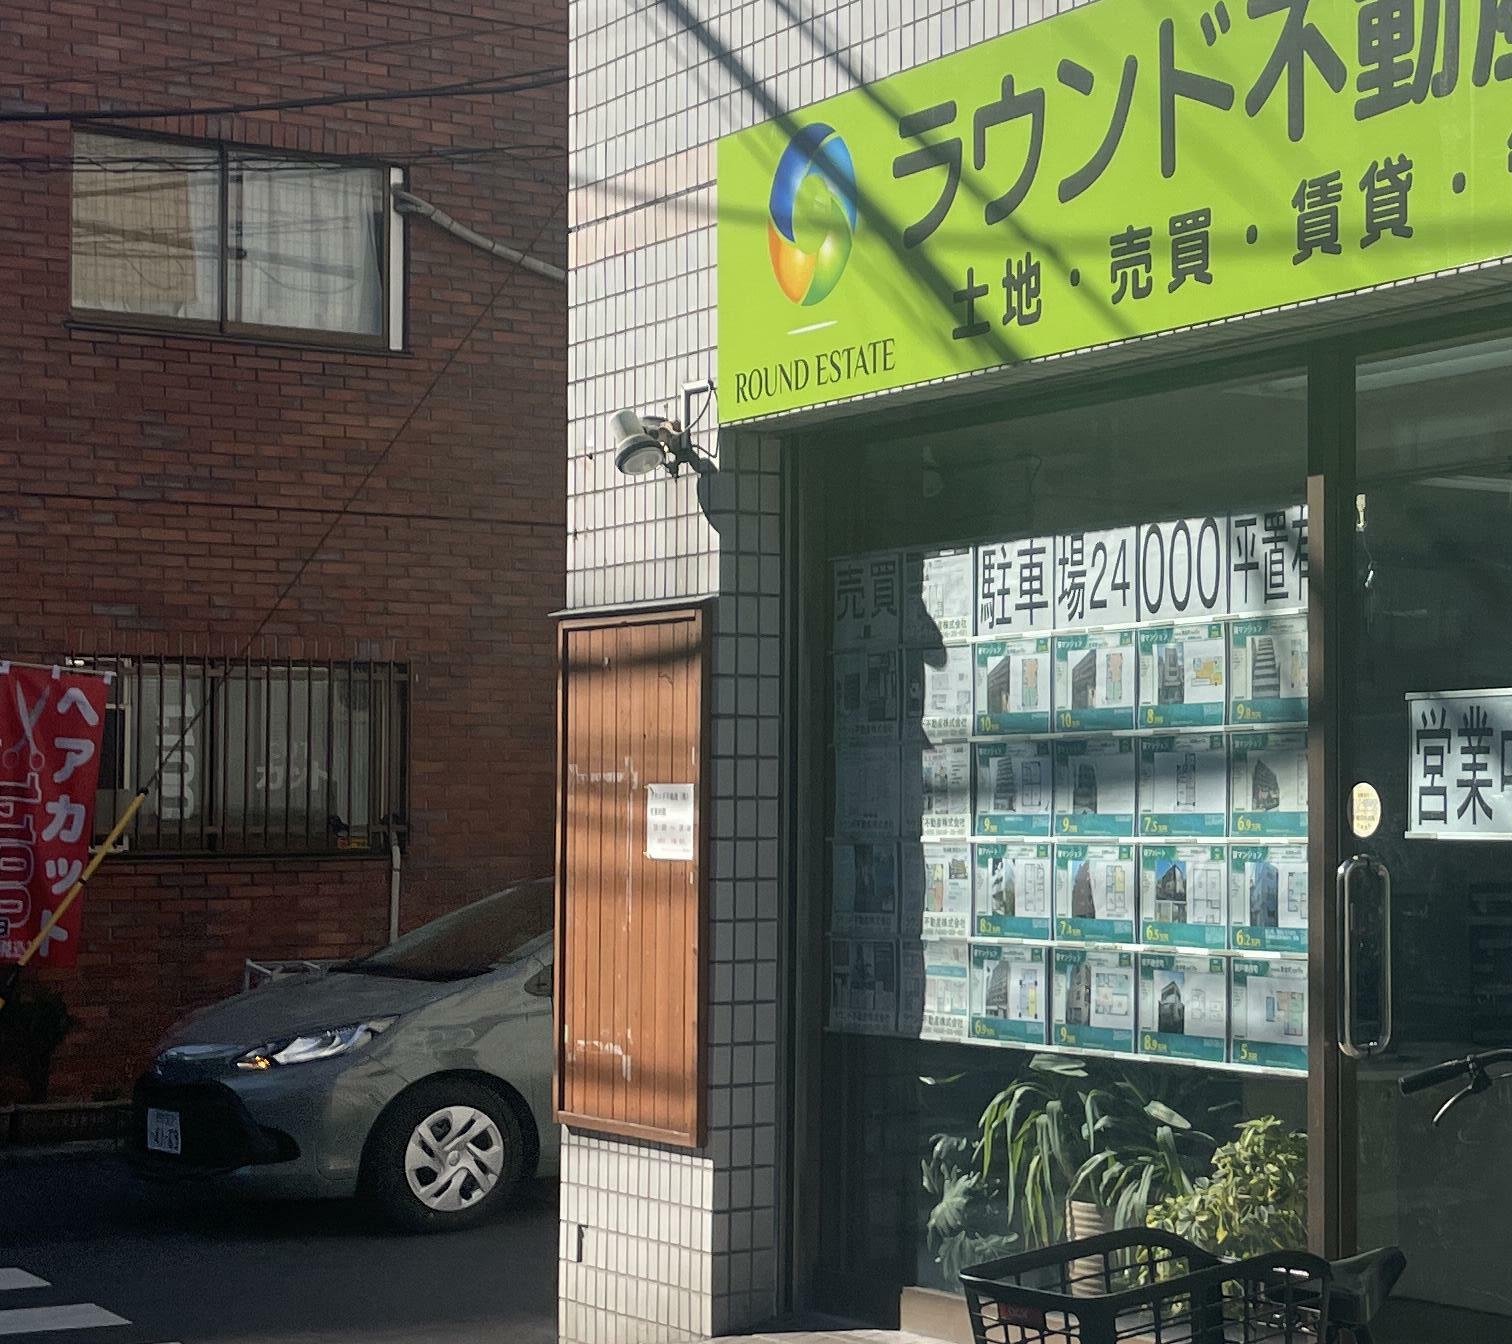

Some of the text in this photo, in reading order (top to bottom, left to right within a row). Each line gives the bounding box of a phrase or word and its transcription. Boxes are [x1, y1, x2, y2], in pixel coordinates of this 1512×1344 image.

[734, 336, 897, 402] ROUND ESTATE
[39, 686, 101, 959] ヘアカット
